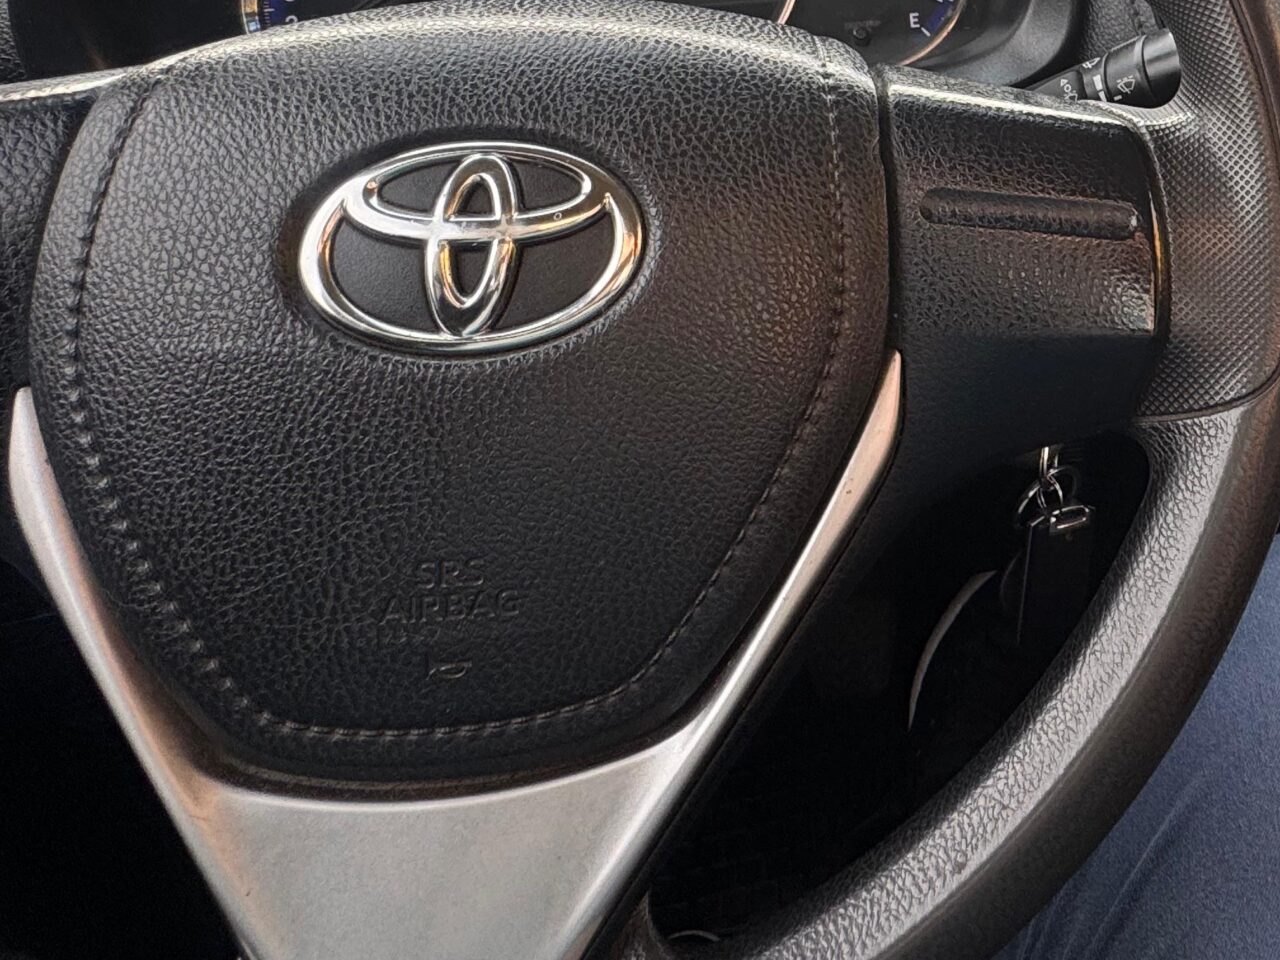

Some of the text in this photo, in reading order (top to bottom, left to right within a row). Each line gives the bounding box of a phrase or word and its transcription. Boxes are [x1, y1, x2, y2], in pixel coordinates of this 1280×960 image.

[909, 12, 920, 28] E
[418, 558, 485, 589] SRS
[379, 590, 520, 625] AIRBAG
